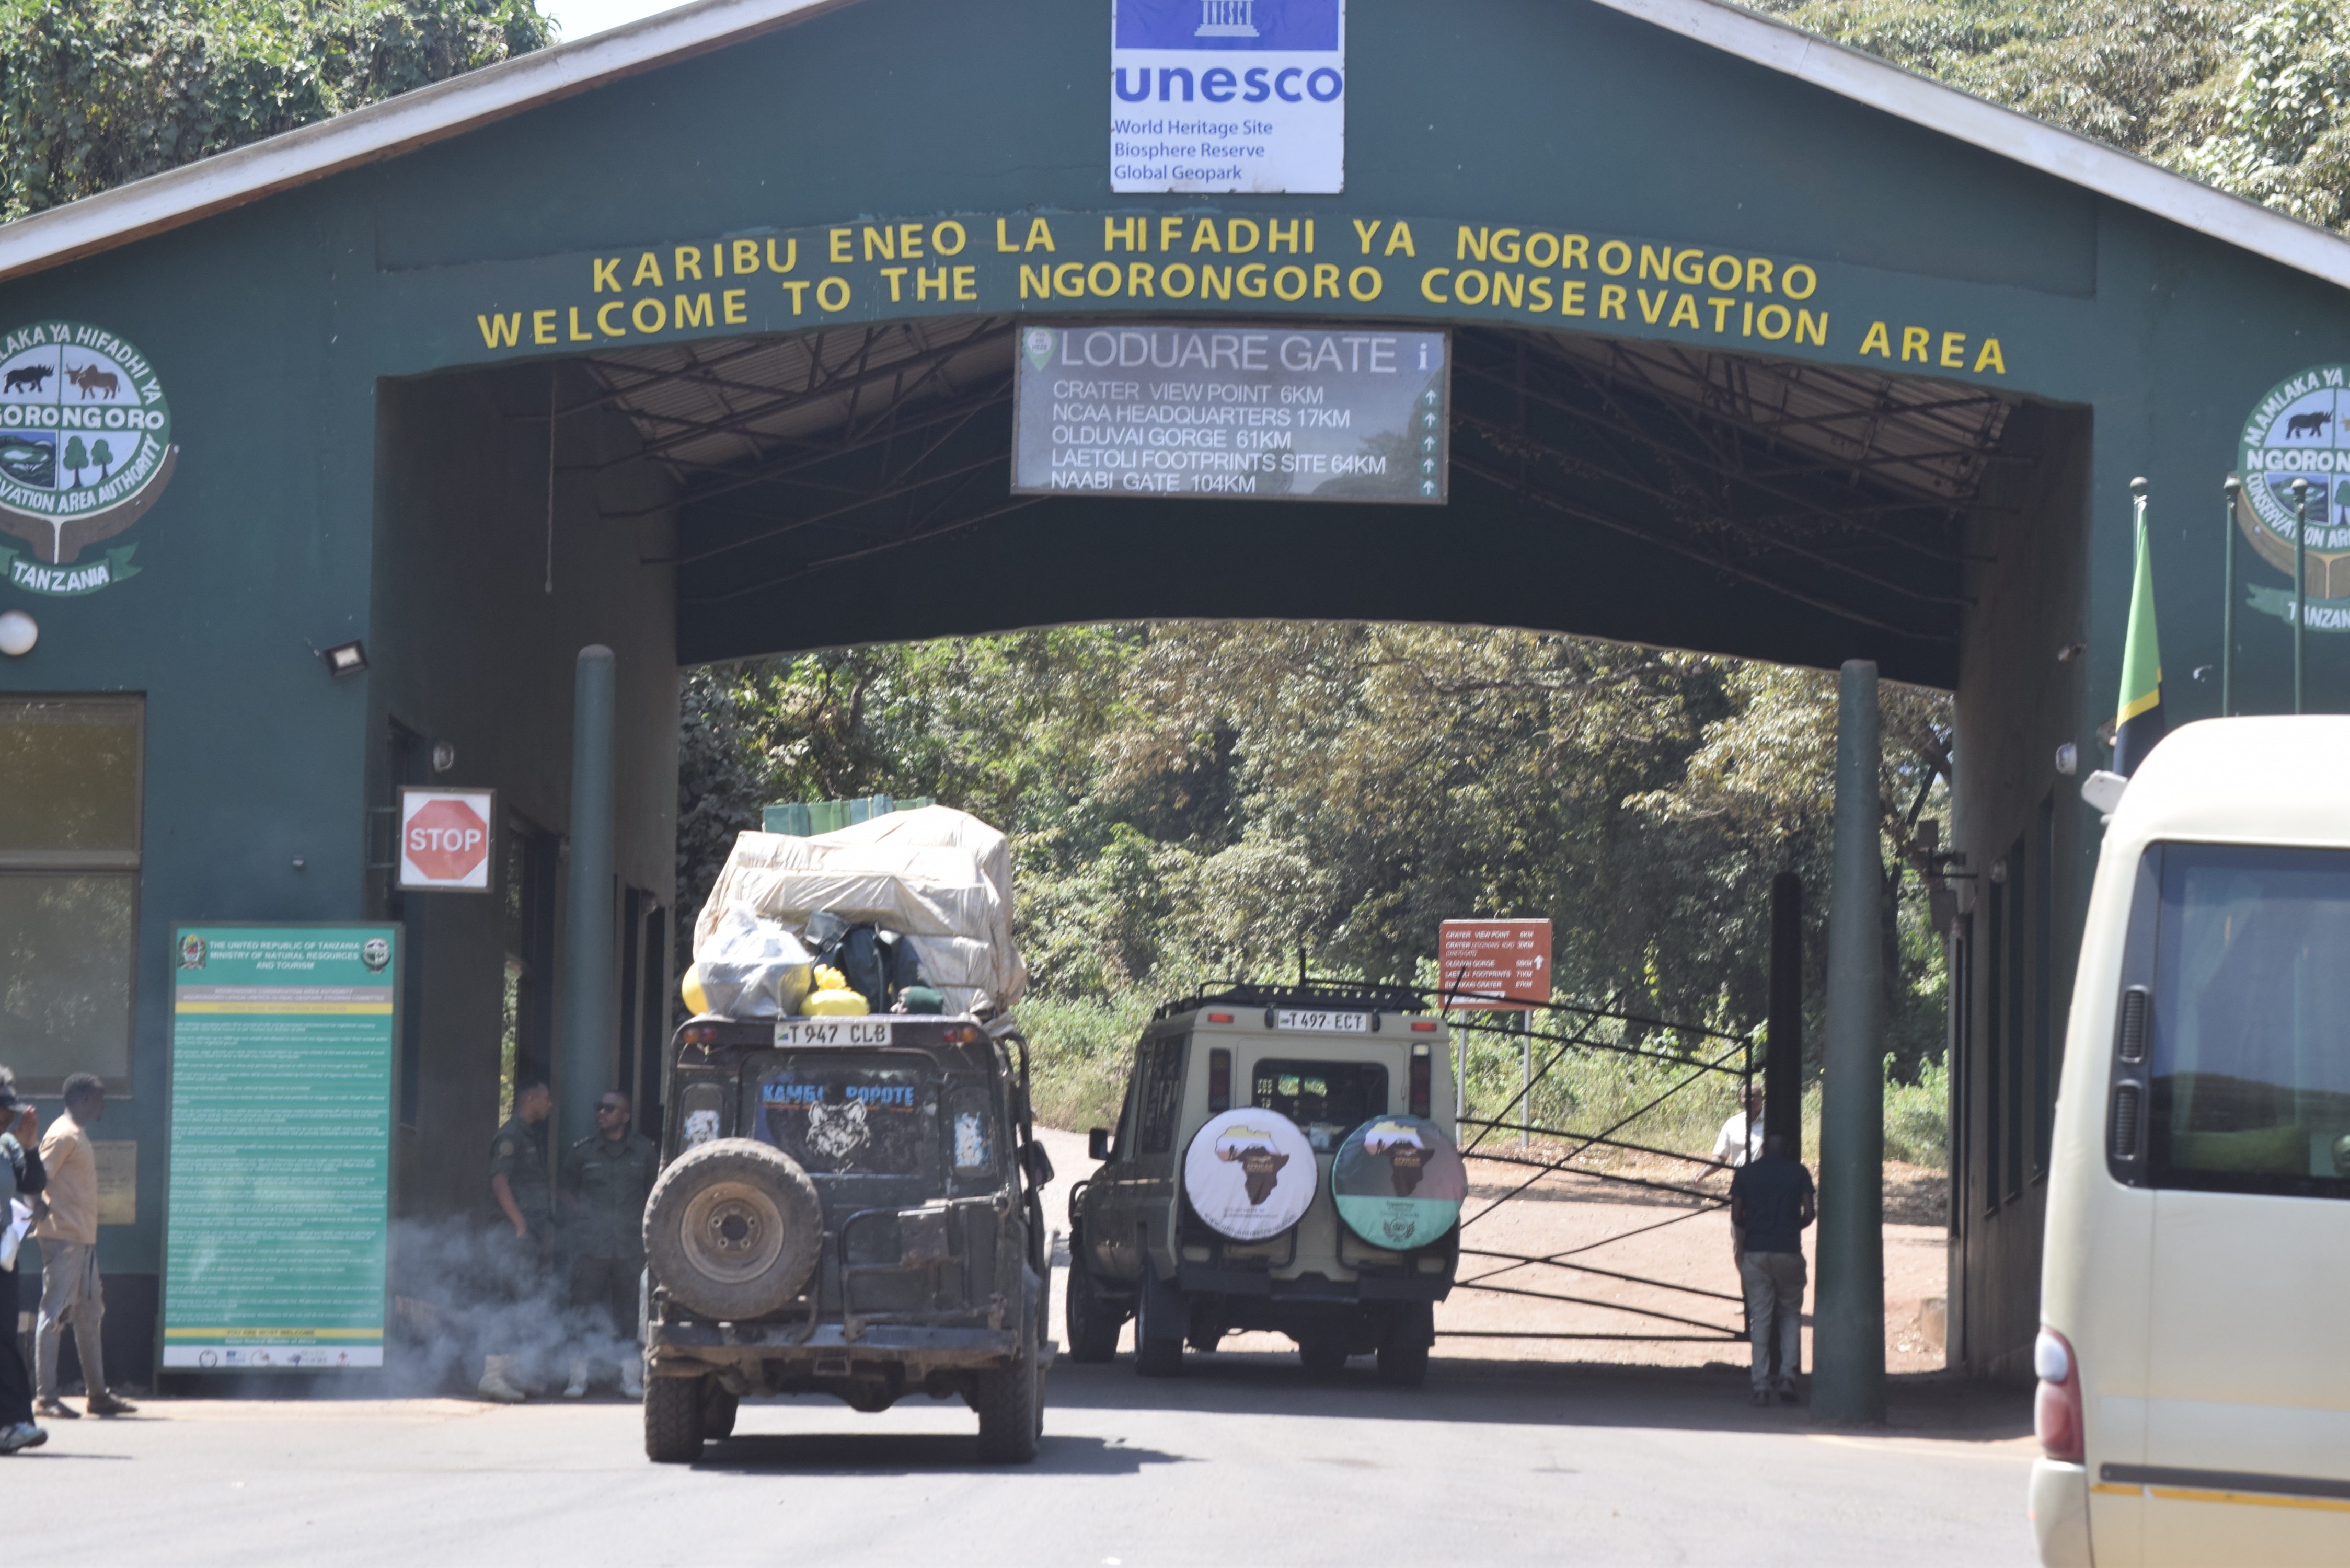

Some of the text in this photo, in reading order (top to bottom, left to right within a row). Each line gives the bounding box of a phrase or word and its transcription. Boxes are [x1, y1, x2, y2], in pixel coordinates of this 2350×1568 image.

[1115, 66, 1343, 103] unesco
[1115, 119, 1273, 139] World Heritage Site
[1115, 142, 1265, 160] Biosphere Reserve
[1114, 164, 1242, 183] Global Geopark
[593, 217, 1817, 301] KARIBU ENEO LA HIFADHI YA NGORONGORO
[477, 262, 2006, 374] WELCOME TO THE NGORONGORO CONSERVATION AREA
[1061, 330, 1268, 371] LODUARE
[1280, 336, 1398, 374] GATE
[49, 324, 71, 343] YA
[76, 325, 150, 379] HIFADHI
[140, 377, 163, 406] YA
[1053, 381, 1324, 405] CRATER VIEW POINT 6KM
[1053, 405, 1350, 429] NCAA HEADQUARTERS 17KM
[2244, 367, 2343, 447] MAMLAKA YA
[1053, 426, 1292, 449] OLDUVAI GORGE 61KM
[57, 489, 97, 514] AREA
[98, 433, 161, 504] AUTHORITY
[1052, 449, 1386, 475] LAETOLI FOOTPRINTS SITE 64KM
[1051, 471, 1255, 493] NAABI GATE 104KM
[14, 561, 110, 592] TANZANIA
[410, 828, 482, 852] STOP
[210, 951, 359, 960] MINISTRY OF NATURAL RESOURCES
[227, 941, 258, 950] UNITED
[260, 941, 303, 950] REPUBLIC
[304, 941, 316, 950] OF
[256, 961, 315, 970] AND TOURISM
[1472, 971, 1512, 979] FOOTPRINTS
[1289, 1012, 1362, 1029] T 497 ECT
[789, 1024, 885, 1043] T 947 CLB
